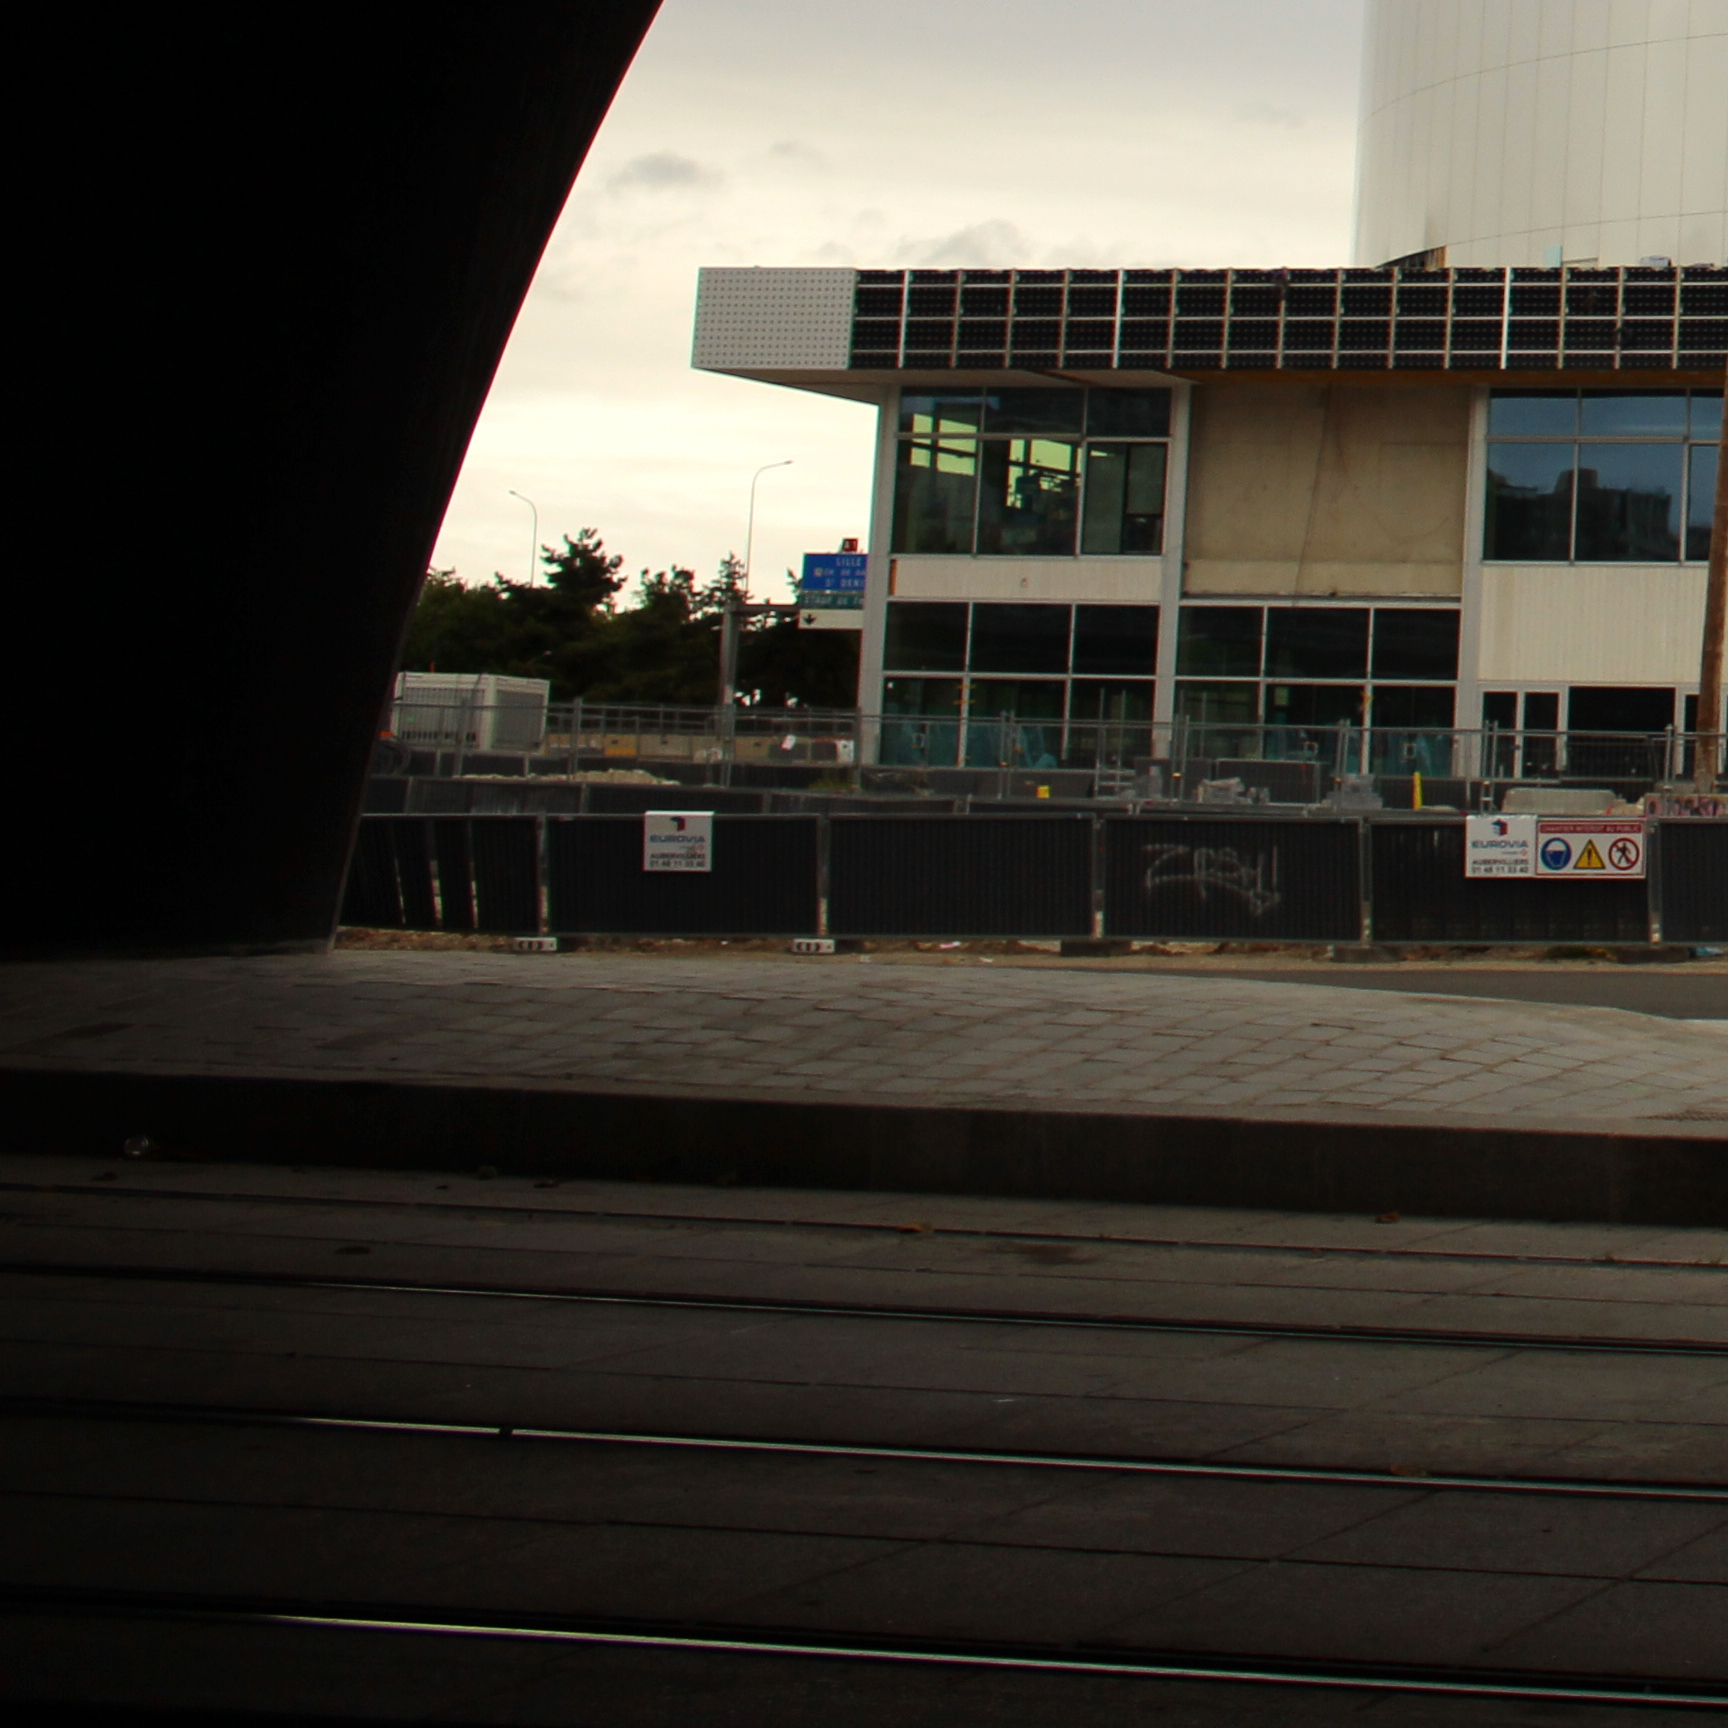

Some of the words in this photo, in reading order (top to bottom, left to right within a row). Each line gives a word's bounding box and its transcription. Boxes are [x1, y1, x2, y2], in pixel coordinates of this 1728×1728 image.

[836, 557, 861, 567] LILLE
[841, 579, 864, 588] DENI
[1616, 825, 1639, 833] PUBLIC
[650, 835, 705, 843] EUROVIA
[1471, 839, 1528, 848] EUROVIA
